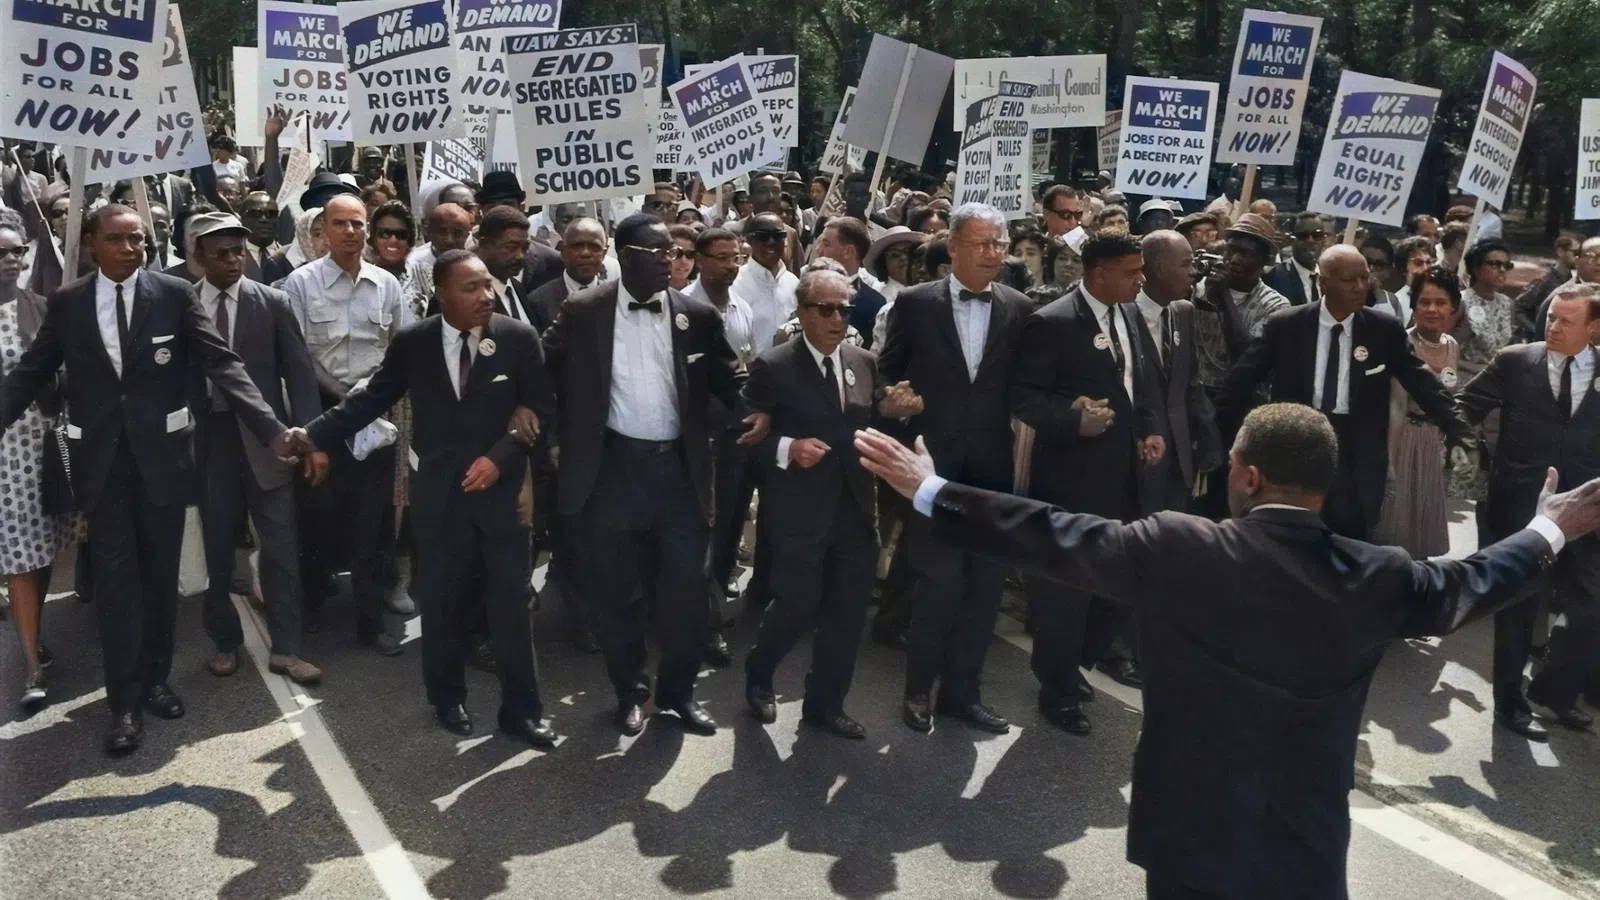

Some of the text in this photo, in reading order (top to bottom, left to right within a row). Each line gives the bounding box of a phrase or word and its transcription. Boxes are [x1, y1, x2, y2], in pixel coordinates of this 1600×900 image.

[62, 12, 108, 32] FOR
[298, 16, 325, 31] WE
[377, 9, 413, 36] WE
[462, 3, 553, 28] DEMAND
[354, 23, 445, 65] DEMAND
[460, 35, 491, 51] AN
[511, 27, 632, 52] UAW SAYS:
[1272, 27, 1291, 43] WE
[20, 38, 140, 81] JOBS
[297, 51, 327, 60] FOR
[1247, 43, 1305, 65] MARCH
[477, 56, 505, 73] LA
[531, 51, 614, 78] END
[752, 62, 776, 78] WE
[1262, 65, 1284, 76] FOR
[22, 73, 133, 100] FOR ALL
[273, 68, 347, 92] JOBS
[358, 66, 451, 88] VOTING
[698, 76, 720, 93] WE
[754, 71, 793, 91] MAND
[1064, 67, 1101, 96] Council
[1511, 75, 1523, 94] WE
[275, 92, 346, 104] FOR ALL
[515, 72, 637, 104] SEGREGATED
[686, 80, 744, 116] MARCH
[1159, 90, 1182, 103] WE
[1238, 86, 1296, 110] JOBS
[367, 88, 450, 109] RIGHTS
[762, 98, 794, 110] FEPC
[980, 97, 996, 119] WE
[1371, 94, 1410, 114] WE
[1492, 84, 1527, 118] MARCH
[15, 98, 141, 139] NOW!
[535, 98, 621, 125] RULES
[707, 102, 730, 117] FOR
[999, 101, 1024, 118] END
[1135, 102, 1202, 120] MARCH
[1237, 113, 1288, 125] FOR ALL
[1501, 109, 1515, 124] FOR
[370, 105, 452, 135] NOW!
[472, 125, 488, 133] FO
[691, 104, 758, 143] INTEGRATED
[967, 118, 993, 142] DEM
[993, 119, 1029, 137] SEGREGATED
[1154, 119, 1181, 128] FOR
[1340, 115, 1429, 135] DEMAND
[564, 128, 596, 143] IN
[699, 121, 764, 160] SCHOOLS
[1125, 133, 1205, 149] JOBS FOR ALL
[1229, 131, 1291, 154] NOW!
[1479, 117, 1519, 152] INTEGRATED
[536, 140, 634, 168] PUBLIC
[711, 136, 766, 178] NOW!
[965, 151, 991, 166] VOTIN
[997, 140, 1022, 157] RULES
[1122, 150, 1132, 160] A
[1133, 151, 1177, 164] DECENT
[1180, 153, 1204, 166] PAY
[1341, 142, 1405, 172] EQUAL
[1473, 138, 1512, 172] SCHOOLS
[964, 170, 990, 185] RIGHT
[1003, 163, 1013, 172] IN
[1333, 162, 1403, 192] RIGHTS
[534, 165, 641, 195] SCHOOLS
[994, 174, 1022, 192] PUBLIC
[1127, 168, 1198, 189] NOW!
[1468, 163, 1505, 195] NOW!
[961, 188, 989, 206] NOW
[992, 194, 1022, 212] SCHOOLS
[1325, 185, 1399, 216] NOW!
